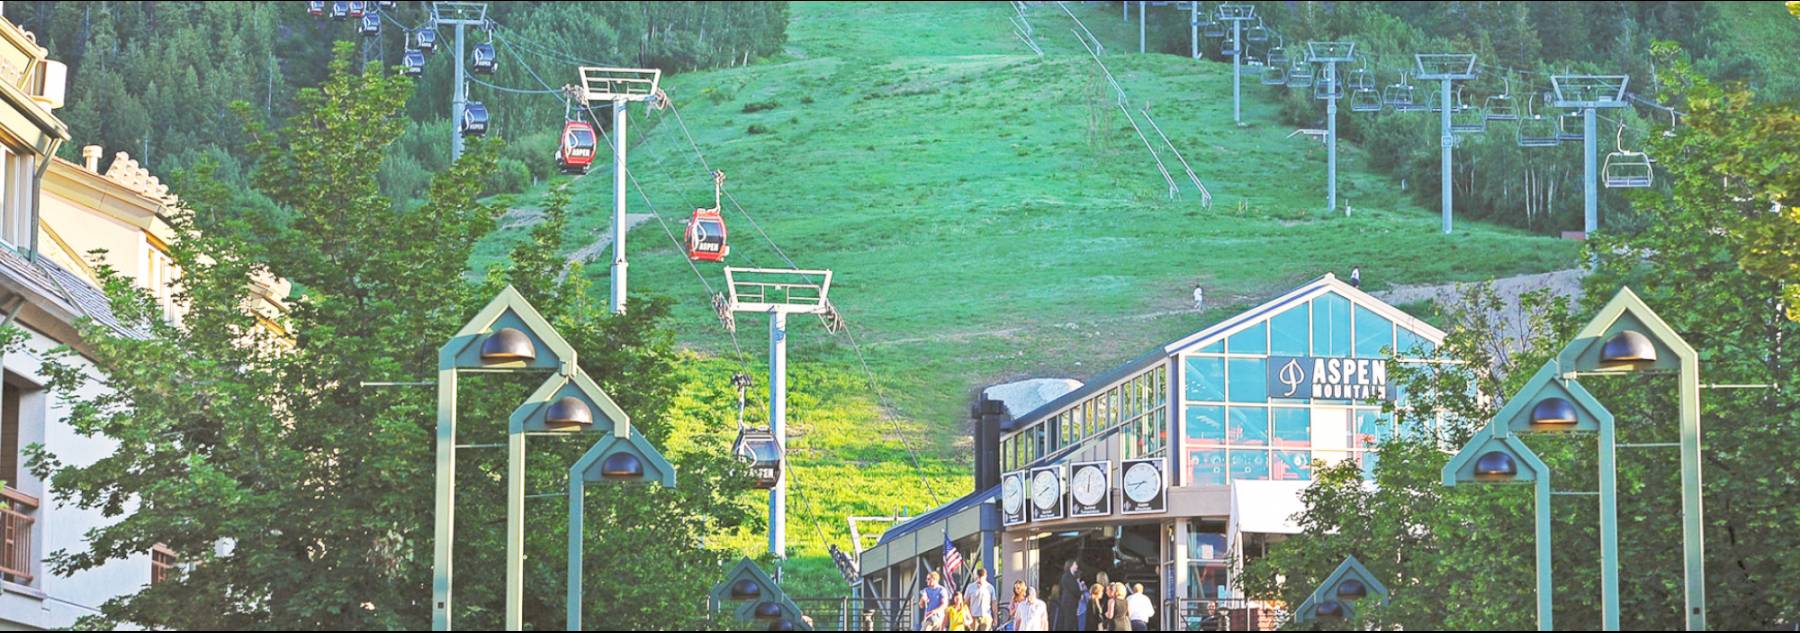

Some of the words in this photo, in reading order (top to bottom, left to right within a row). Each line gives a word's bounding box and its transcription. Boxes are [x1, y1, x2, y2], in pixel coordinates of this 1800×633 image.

[572, 149, 590, 157] ASPEN
[699, 242, 719, 251] ASPEN
[1312, 358, 1386, 385] ASPEN
[1312, 384, 1386, 399] MOUNTAIN
